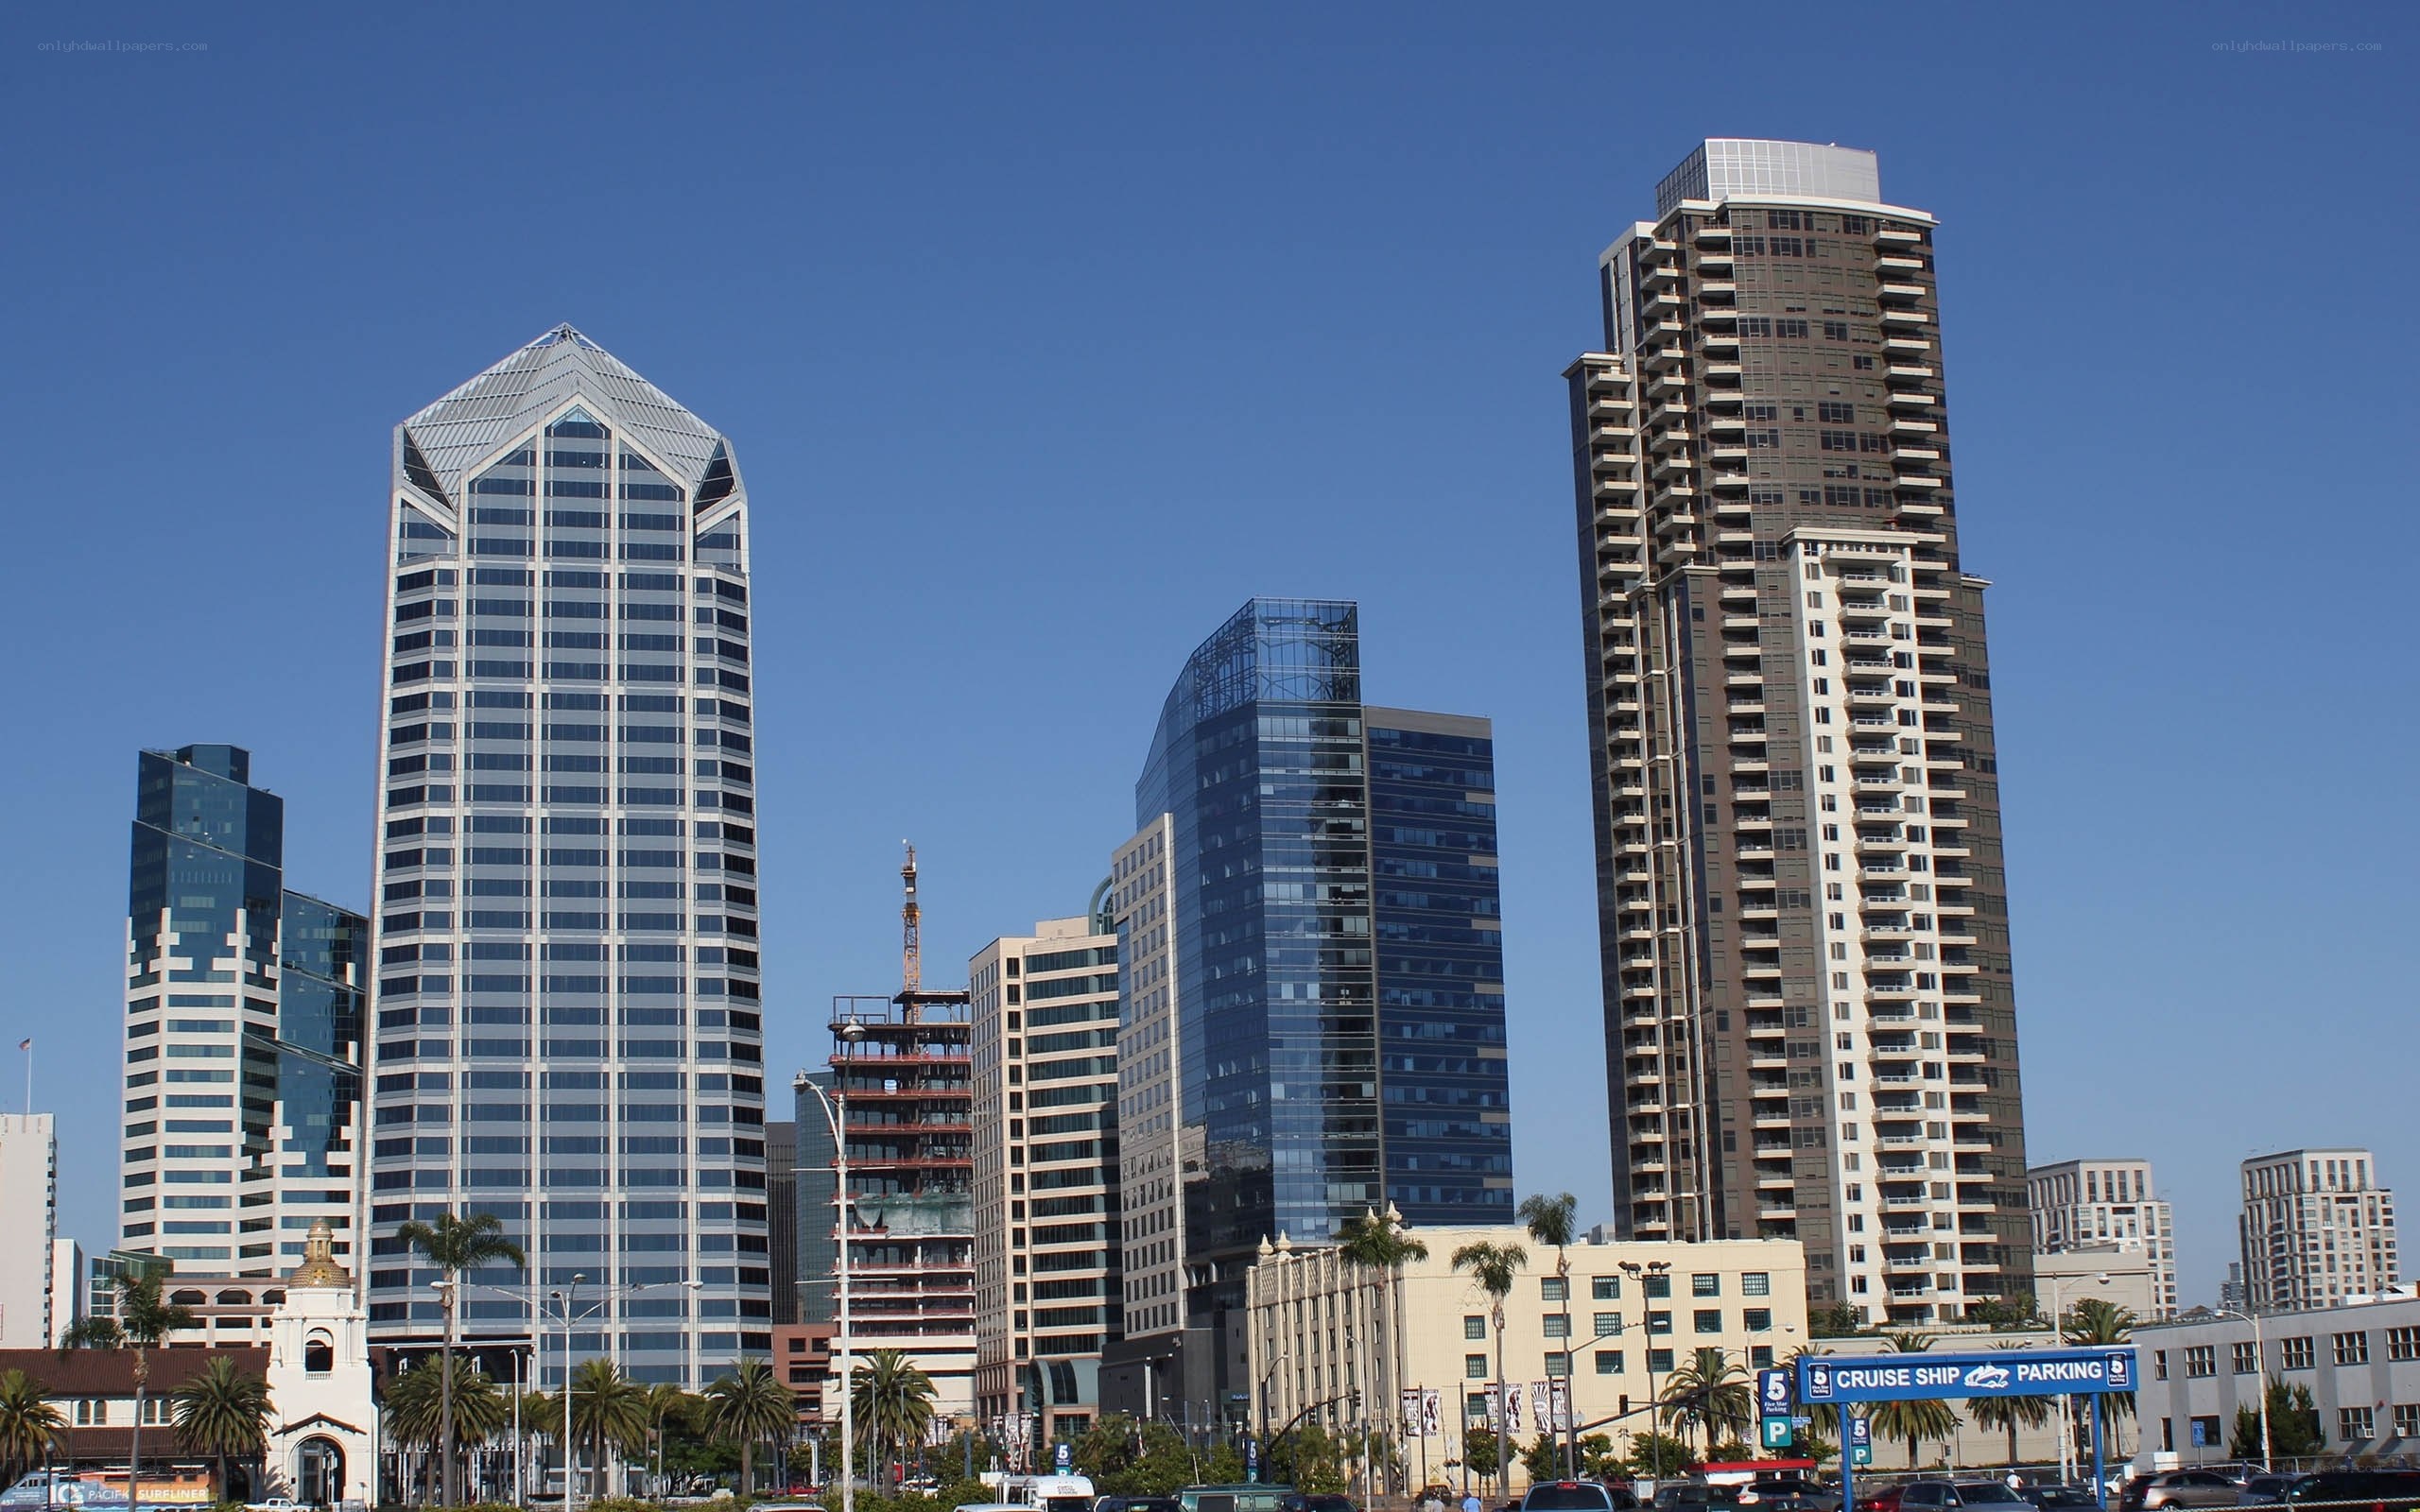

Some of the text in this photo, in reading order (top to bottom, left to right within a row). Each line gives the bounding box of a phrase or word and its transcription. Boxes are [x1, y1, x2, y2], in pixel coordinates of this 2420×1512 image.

[1836, 1362, 2102, 1388] CRUISE SHIP PARKING
[1766, 1372, 1786, 1400] 5
[1769, 1421, 1786, 1443] P
[1853, 1419, 1866, 1436] 5
[1059, 1444, 1068, 1459] 5
[1250, 1440, 1256, 1459] 5
[1855, 1449, 1867, 1462] P
[139, 1488, 208, 1501] SURFLINER
